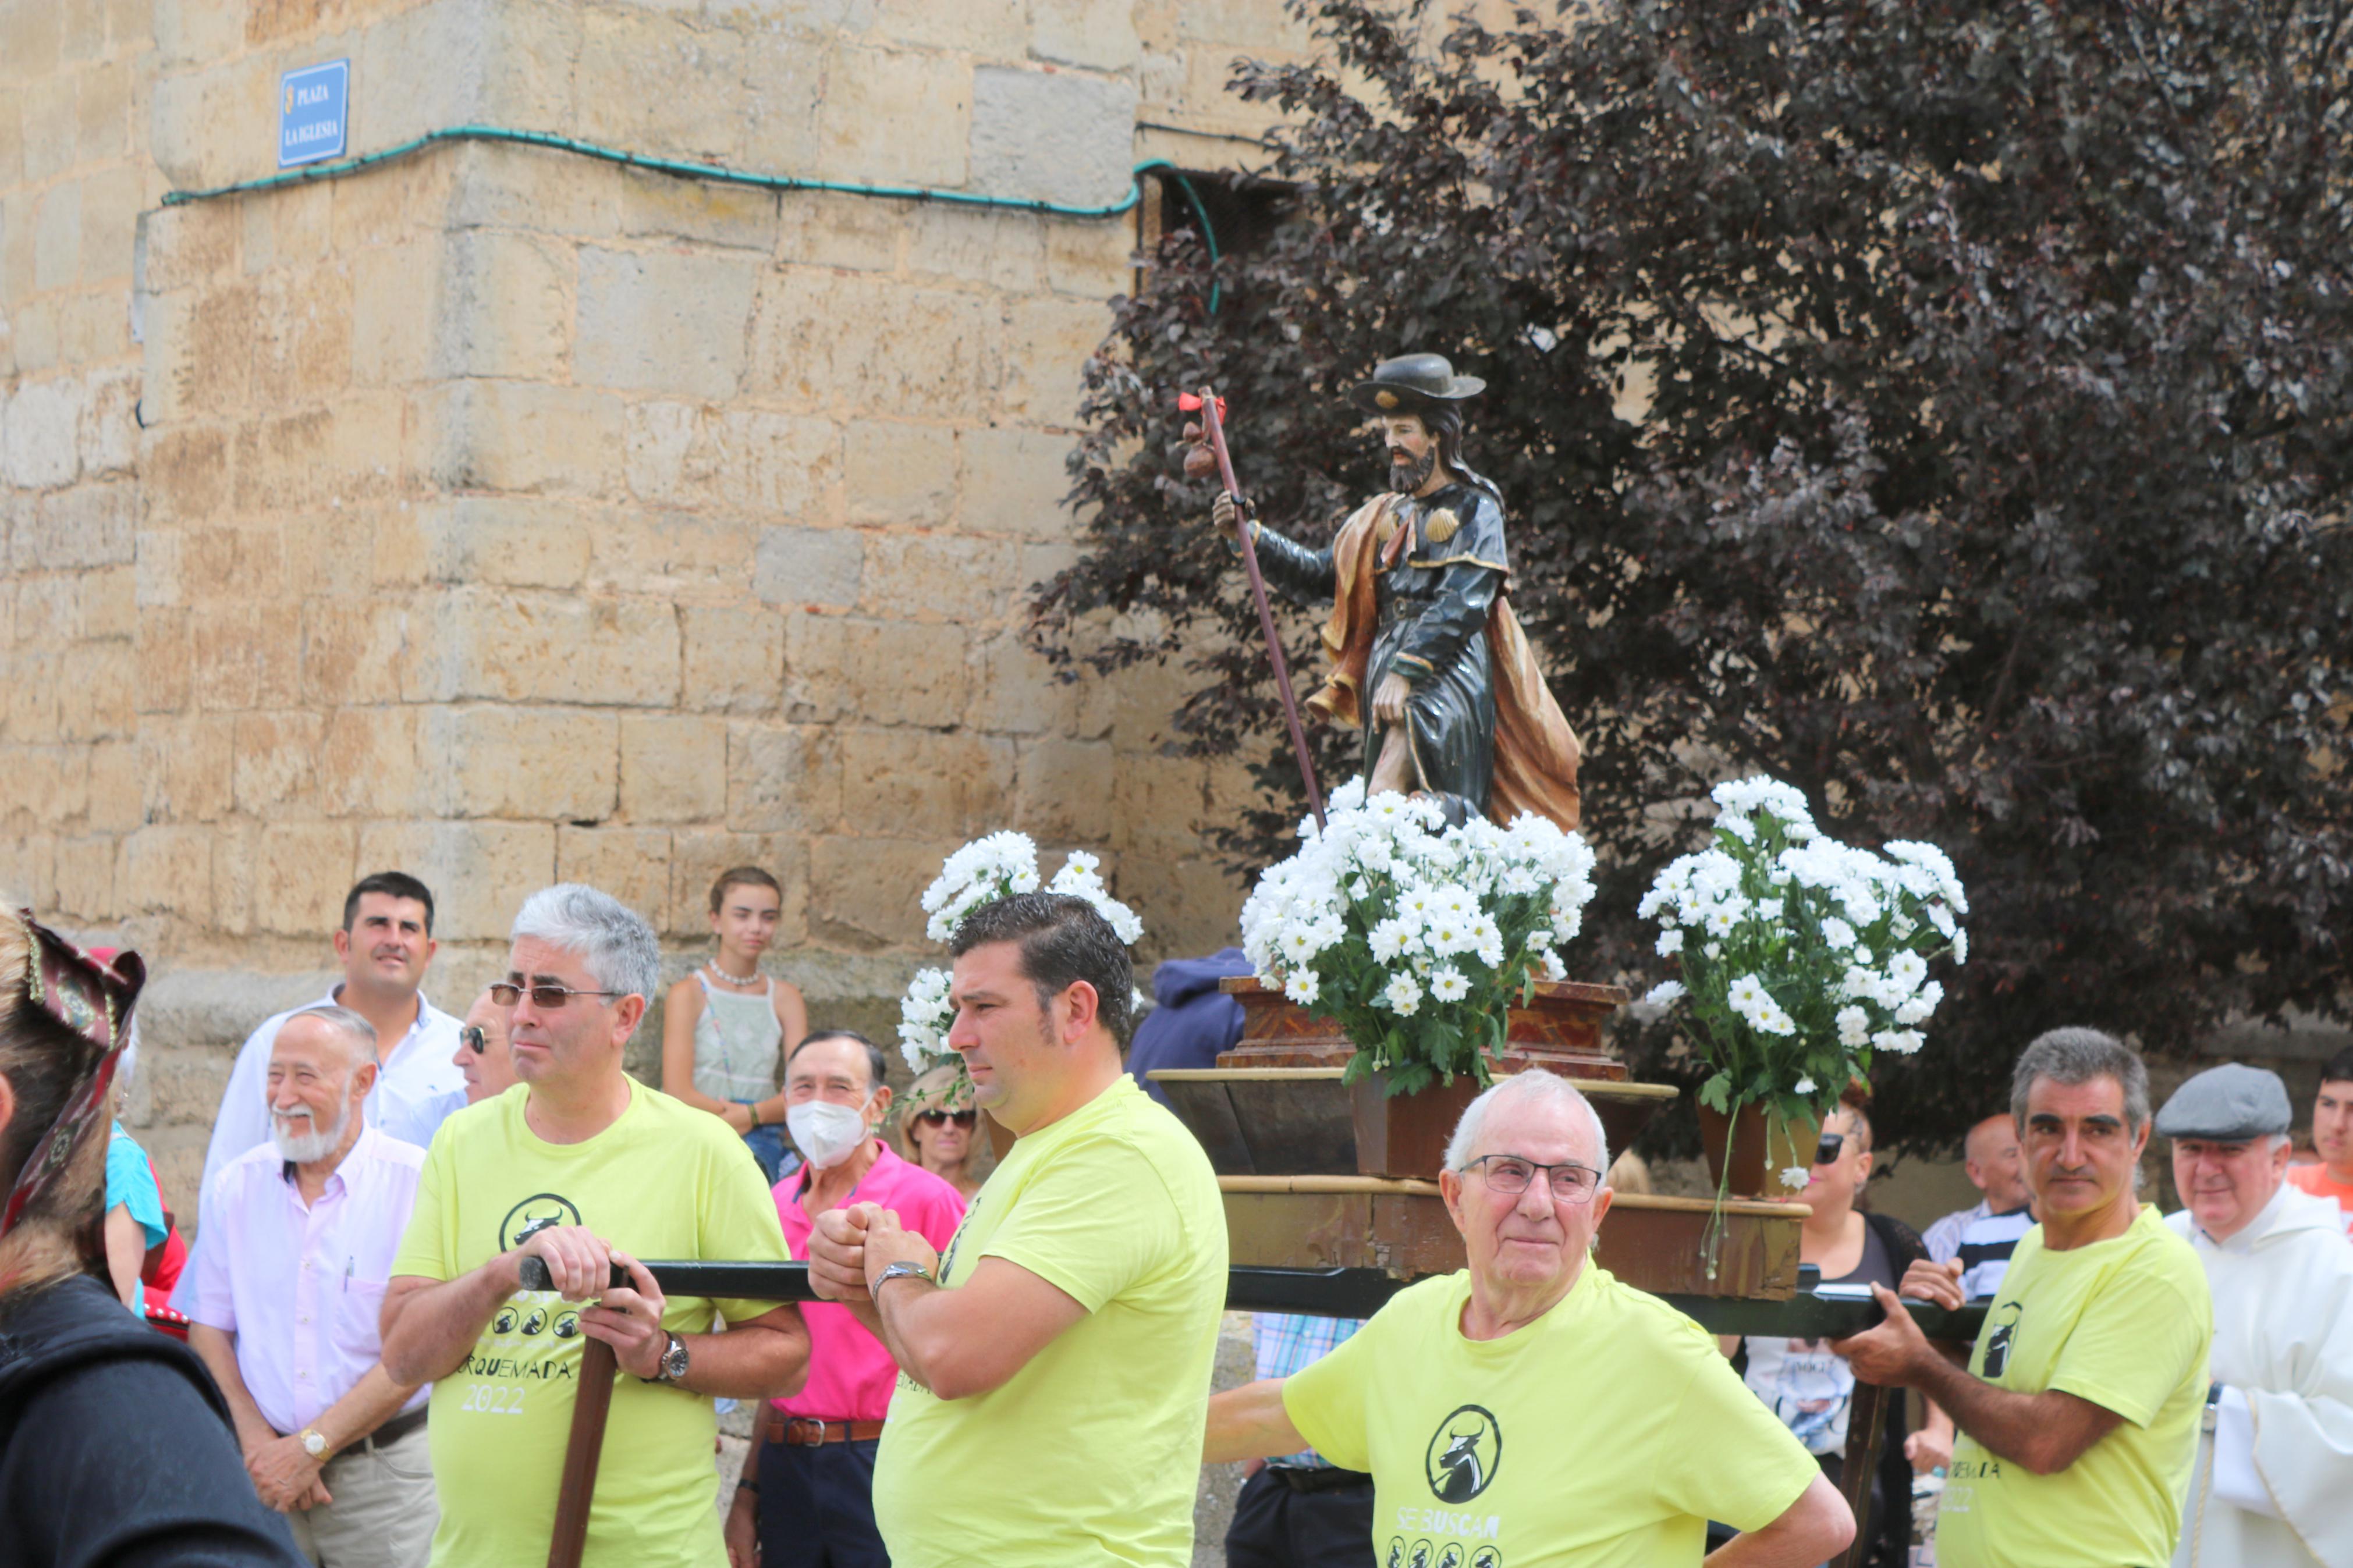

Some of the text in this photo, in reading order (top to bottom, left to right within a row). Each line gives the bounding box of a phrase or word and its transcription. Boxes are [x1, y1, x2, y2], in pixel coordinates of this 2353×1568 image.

[297, 84, 329, 107] PLAZA
[285, 120, 338, 147] LA IGLESIA
[461, 1384, 526, 1414] 2022
[1397, 1507, 1500, 1540] SE BUSCAN
